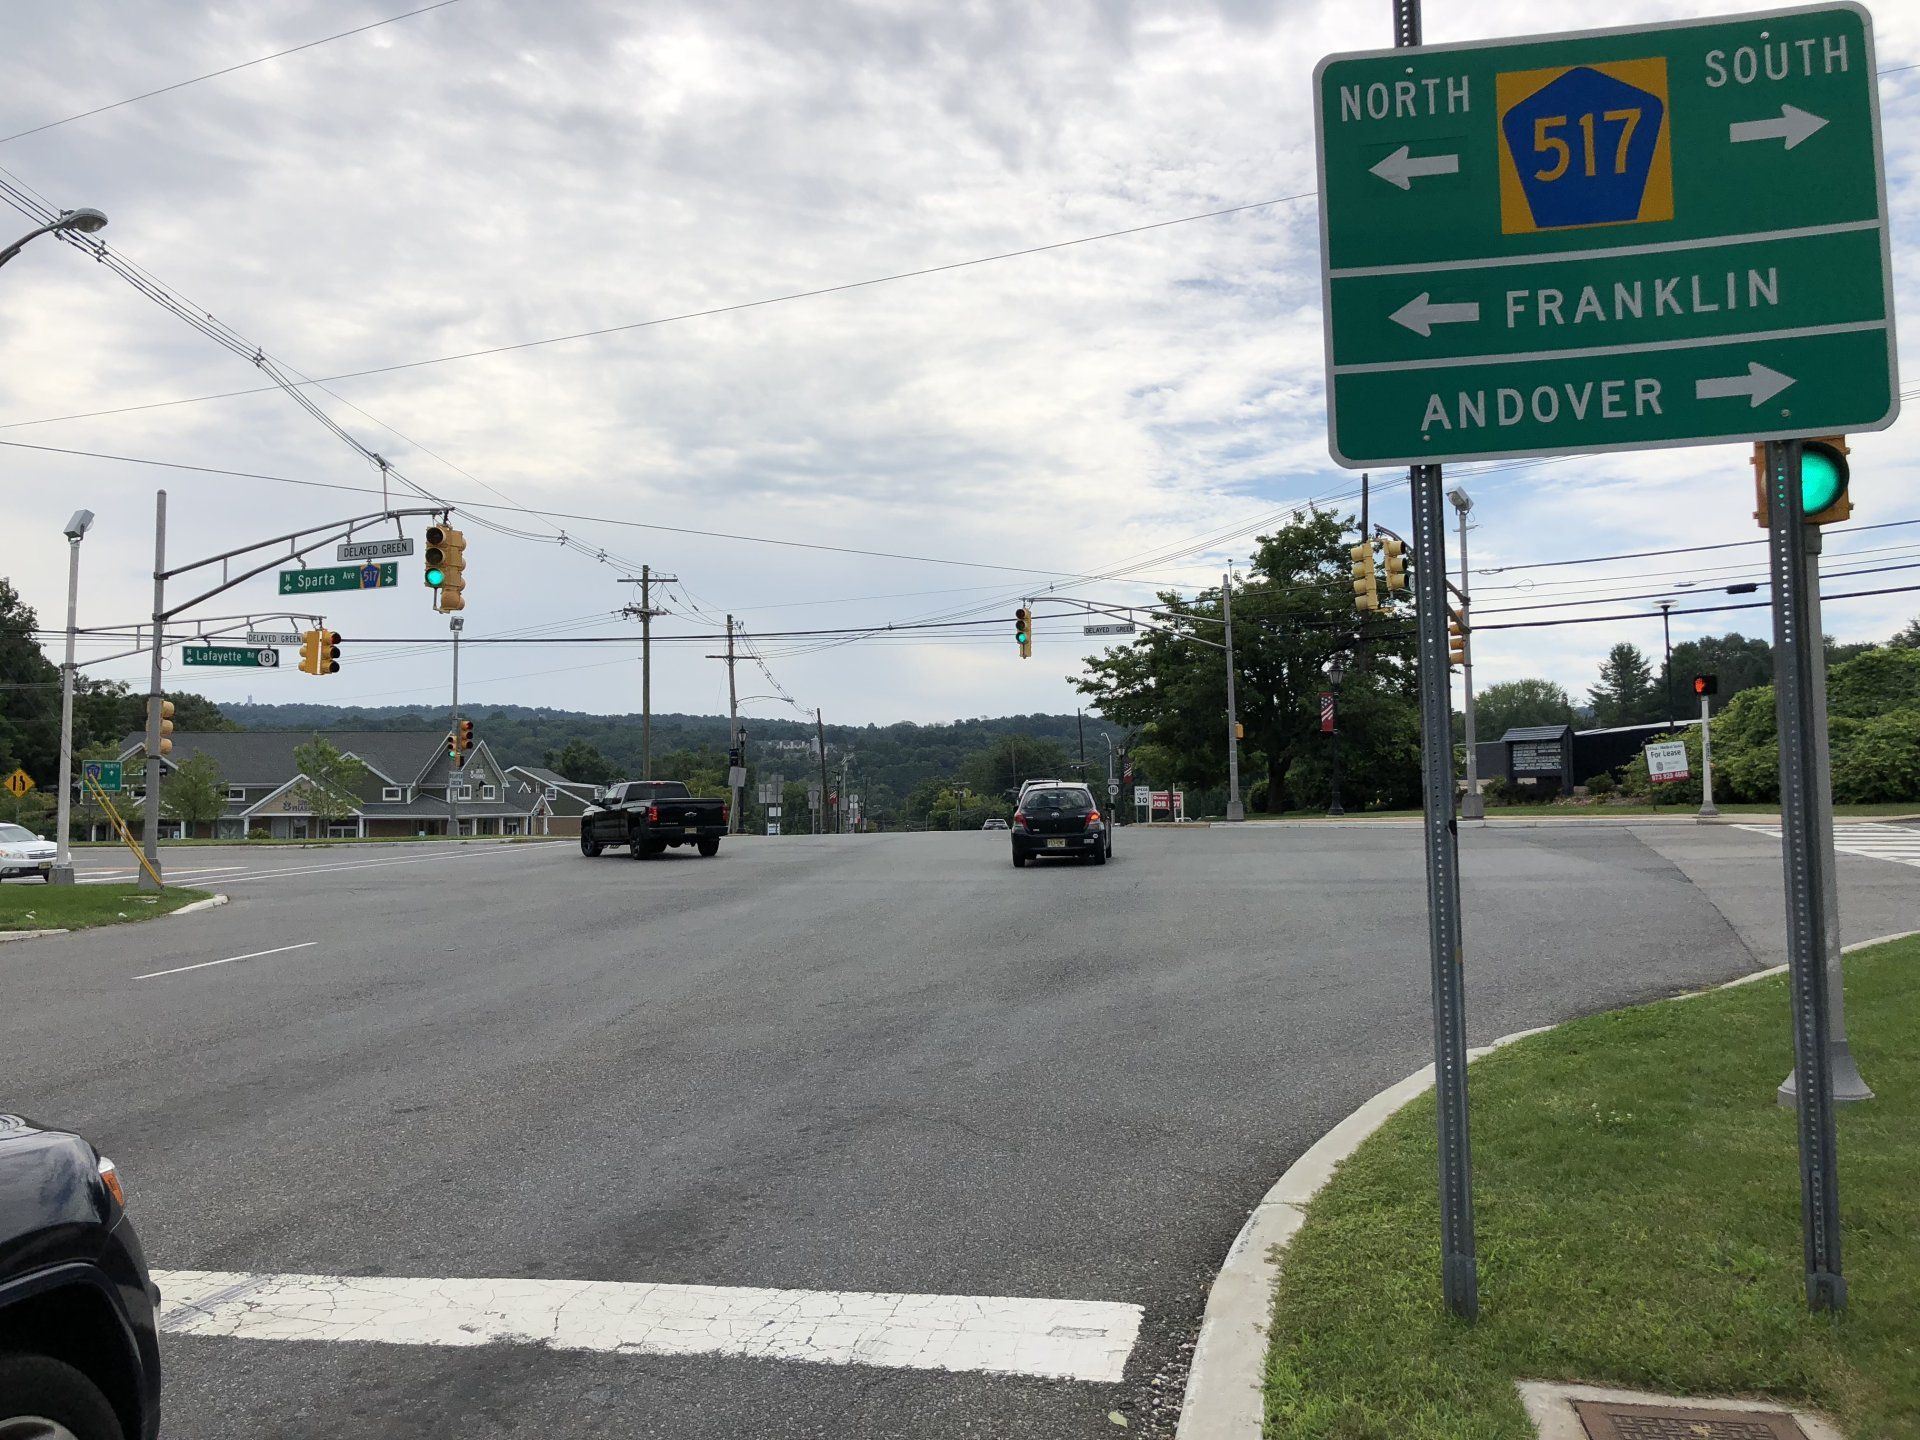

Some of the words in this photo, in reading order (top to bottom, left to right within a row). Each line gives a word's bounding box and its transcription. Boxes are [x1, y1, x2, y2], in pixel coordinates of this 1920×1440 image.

[1705, 35, 1848, 88] SOUTH
[1340, 75, 1469, 122] NORTH
[1534, 108, 1641, 182] 517
[1506, 268, 1778, 328] FRANKLIN
[1420, 378, 1662, 431] ANDOVER
[344, 546, 378, 557] DELAYED
[382, 543, 407, 554] GREEN
[285, 574, 291, 582] N
[298, 573, 335, 589] Sparta
[364, 571, 378, 581] 517
[196, 650, 242, 663] Lafayette
[260, 654, 274, 662] 181
[249, 634, 276, 642] DELAYED
[280, 635, 301, 643] GREEN
